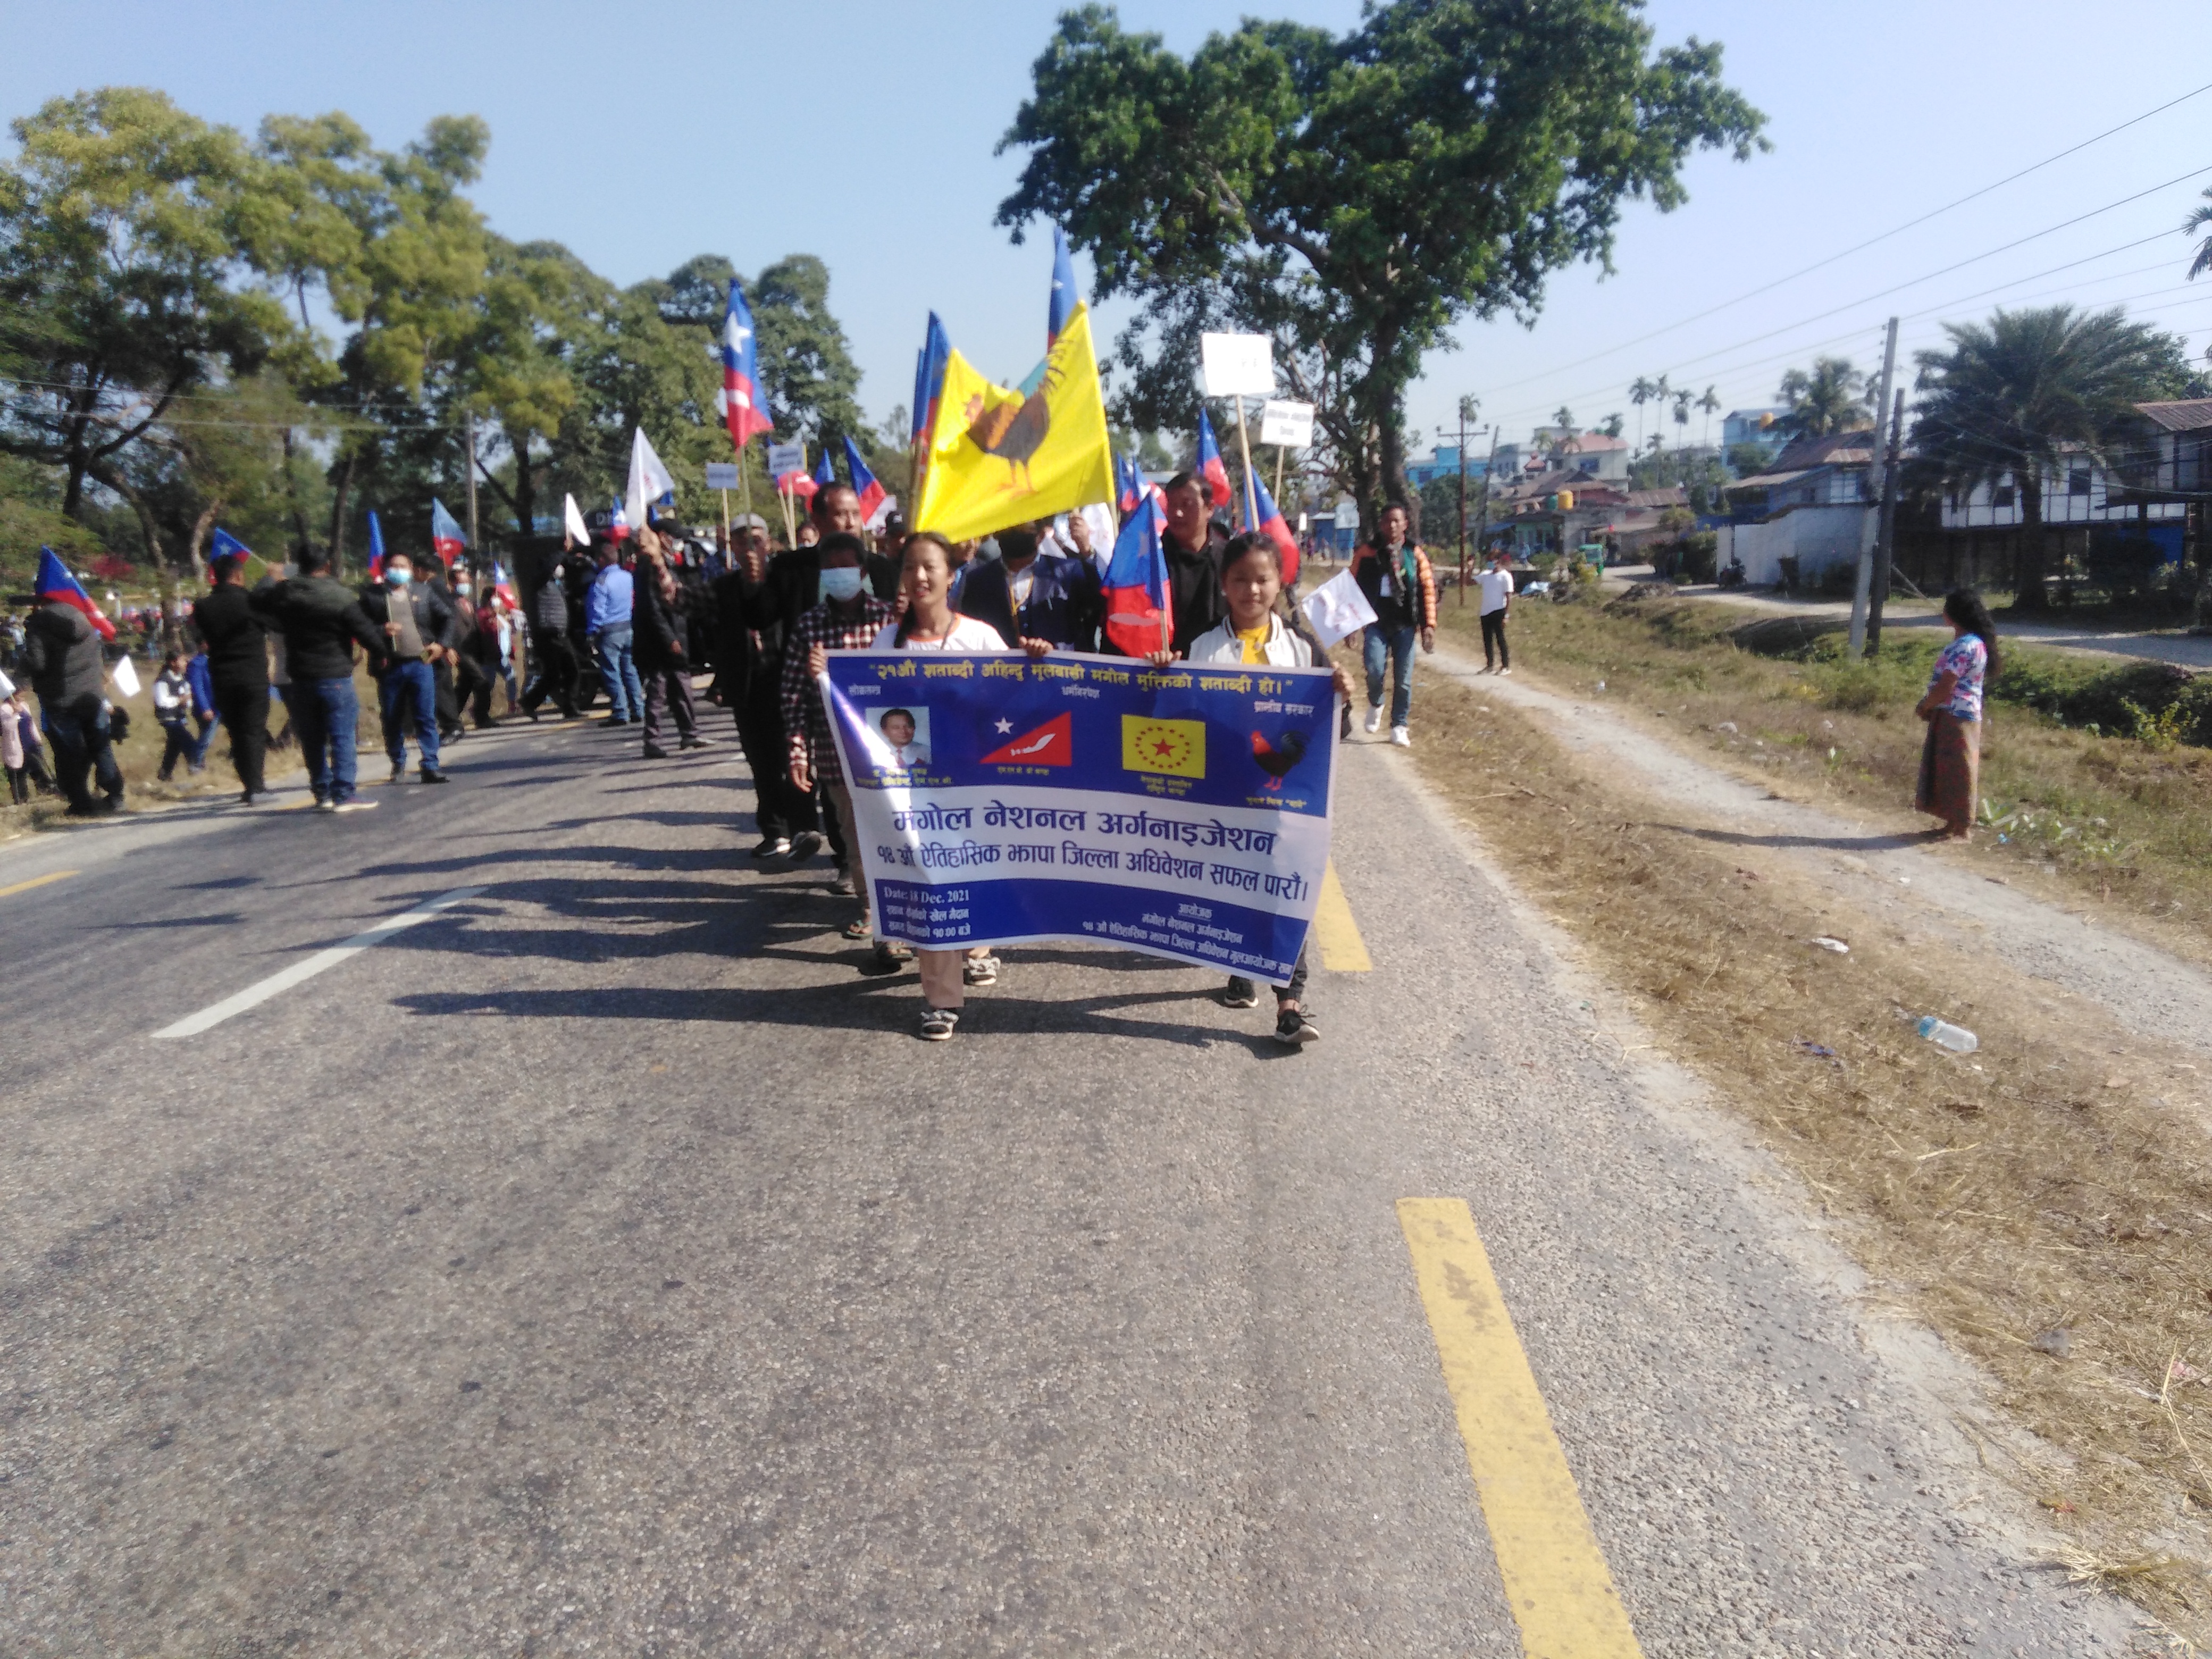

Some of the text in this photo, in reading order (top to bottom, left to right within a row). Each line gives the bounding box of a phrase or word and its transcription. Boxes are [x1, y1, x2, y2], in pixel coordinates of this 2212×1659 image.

[923, 659, 975, 679] शताब्दी
[1199, 674, 1253, 694] शताब्दी
[892, 799, 1277, 855] मंगोल नेशनल अर्गनाइजेशन
[920, 840, 1002, 868] ऐतिहासिक
[1007, 843, 1055, 864] झापा
[1062, 841, 1119, 868] जिल्ला
[1126, 849, 1204, 881] अधिवेशन
[1210, 864, 1260, 891] सफल
[921, 891, 945, 904] Dec.
[947, 889, 969, 903] 2021
